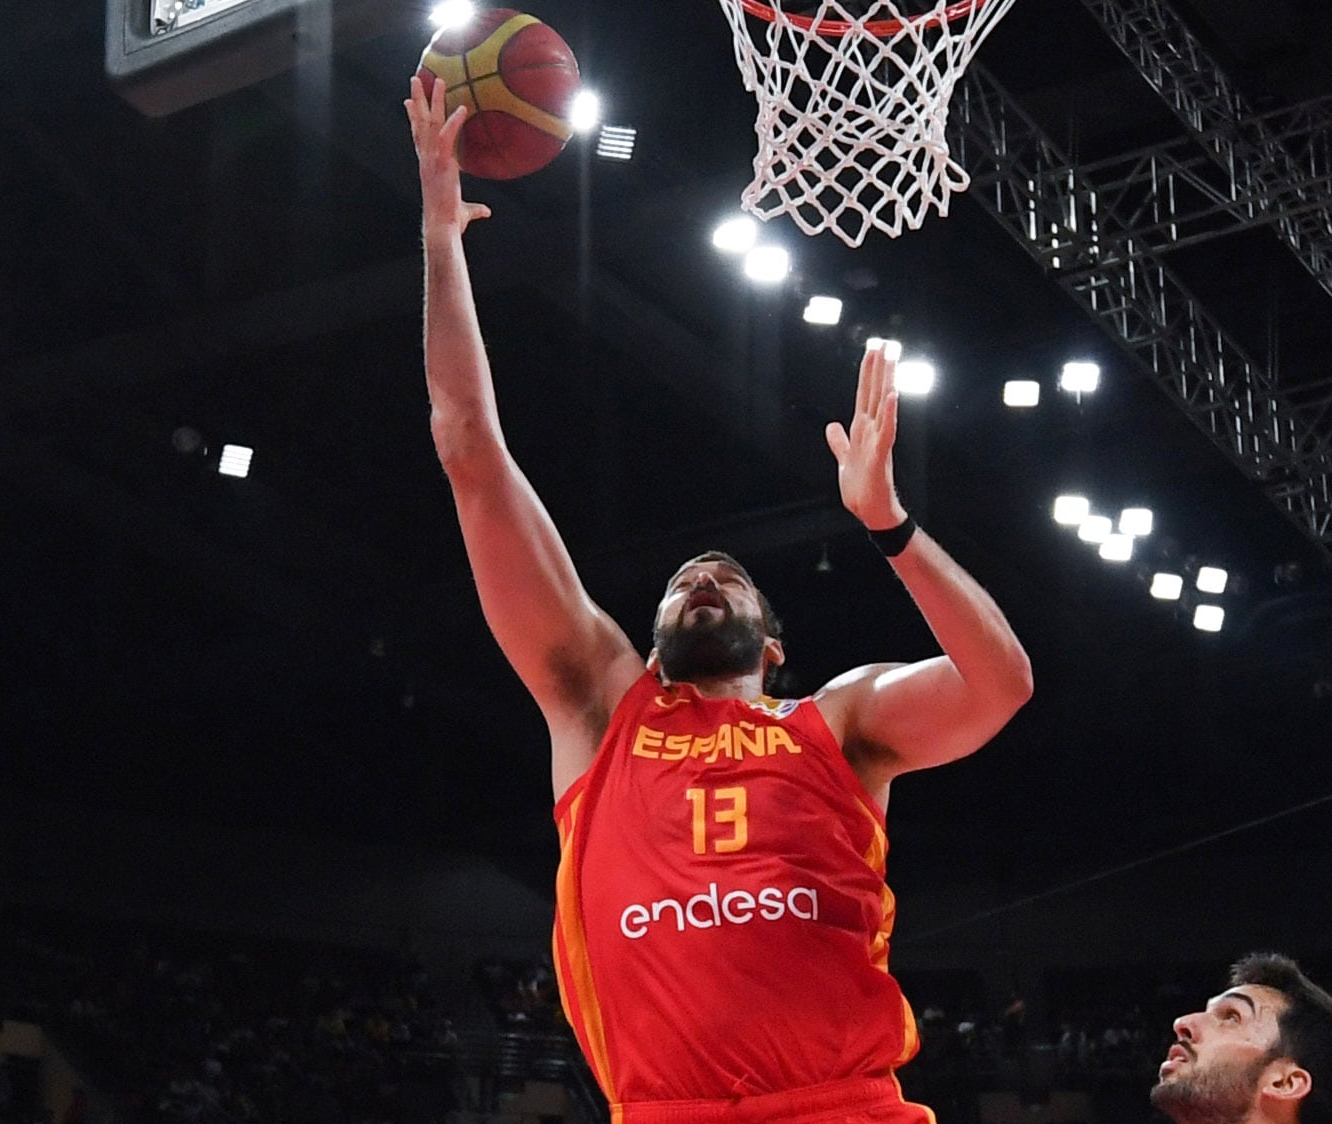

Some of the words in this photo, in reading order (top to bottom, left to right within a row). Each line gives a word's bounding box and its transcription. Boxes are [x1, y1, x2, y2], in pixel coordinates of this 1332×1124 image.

[632, 720, 802, 764] ESPAÑA
[686, 786, 749, 855] 13
[620, 882, 818, 940] endesa
